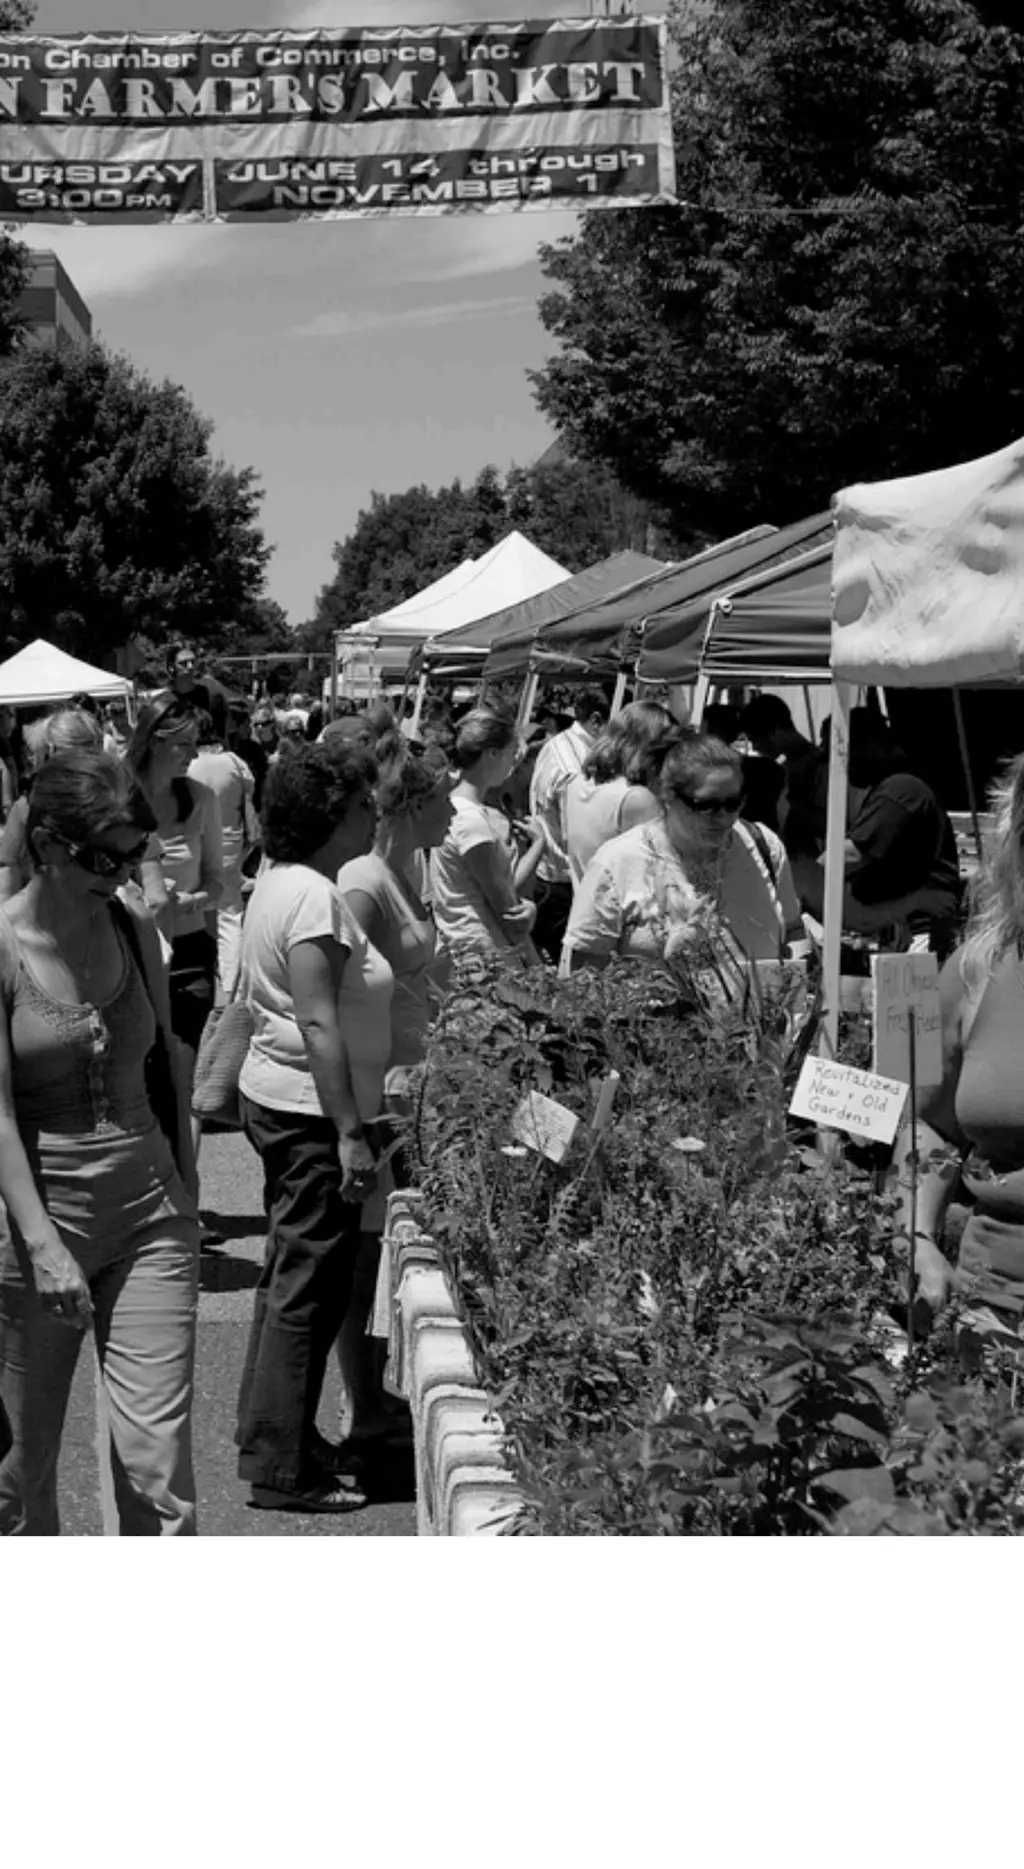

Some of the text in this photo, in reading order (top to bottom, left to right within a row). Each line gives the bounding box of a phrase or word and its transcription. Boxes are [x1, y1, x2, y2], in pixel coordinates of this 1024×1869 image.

[45, 48, 198, 70] Chamber
[211, 49, 244, 68] of
[256, 45, 446, 67] Commerce,
[462, 40, 520, 61] Inc.
[39, 72, 345, 117] FARMER'S
[361, 61, 645, 113] MARKET
[226, 150, 645, 183] JUNE 14 through
[273, 173, 598, 206] NOVEMBER 1
[813, 1061, 900, 1096] Revitalized
[808, 1079, 841, 1098] New
[862, 1094, 889, 1112] Old
[809, 1096, 871, 1127] Gardens
